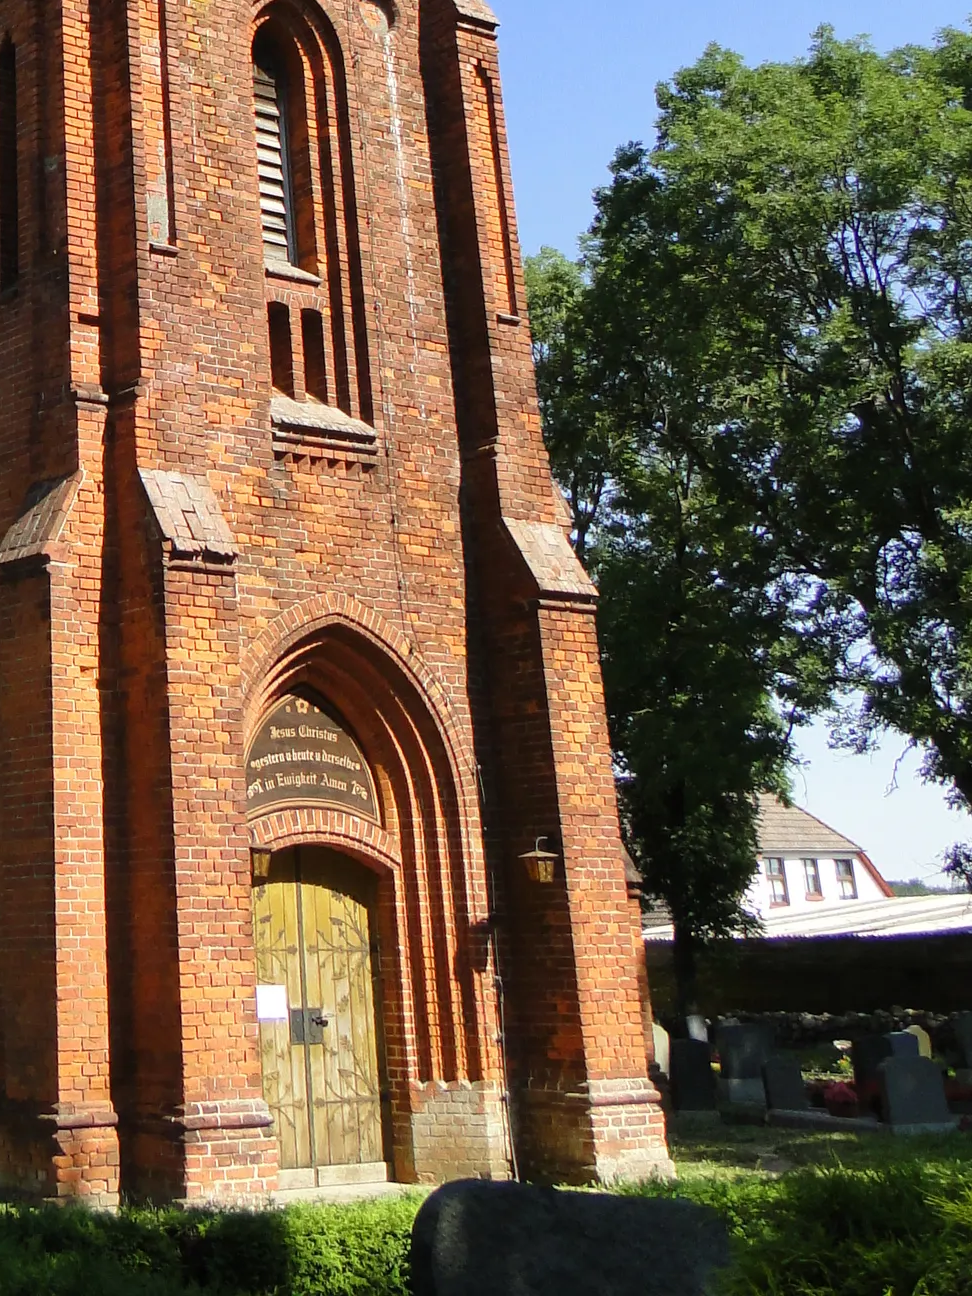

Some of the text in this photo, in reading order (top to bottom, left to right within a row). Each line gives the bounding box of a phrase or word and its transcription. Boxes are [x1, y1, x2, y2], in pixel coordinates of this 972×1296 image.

[270, 724, 338, 742] Jesus Christus
[264, 772, 347, 791] in Ewigkeit Amen
